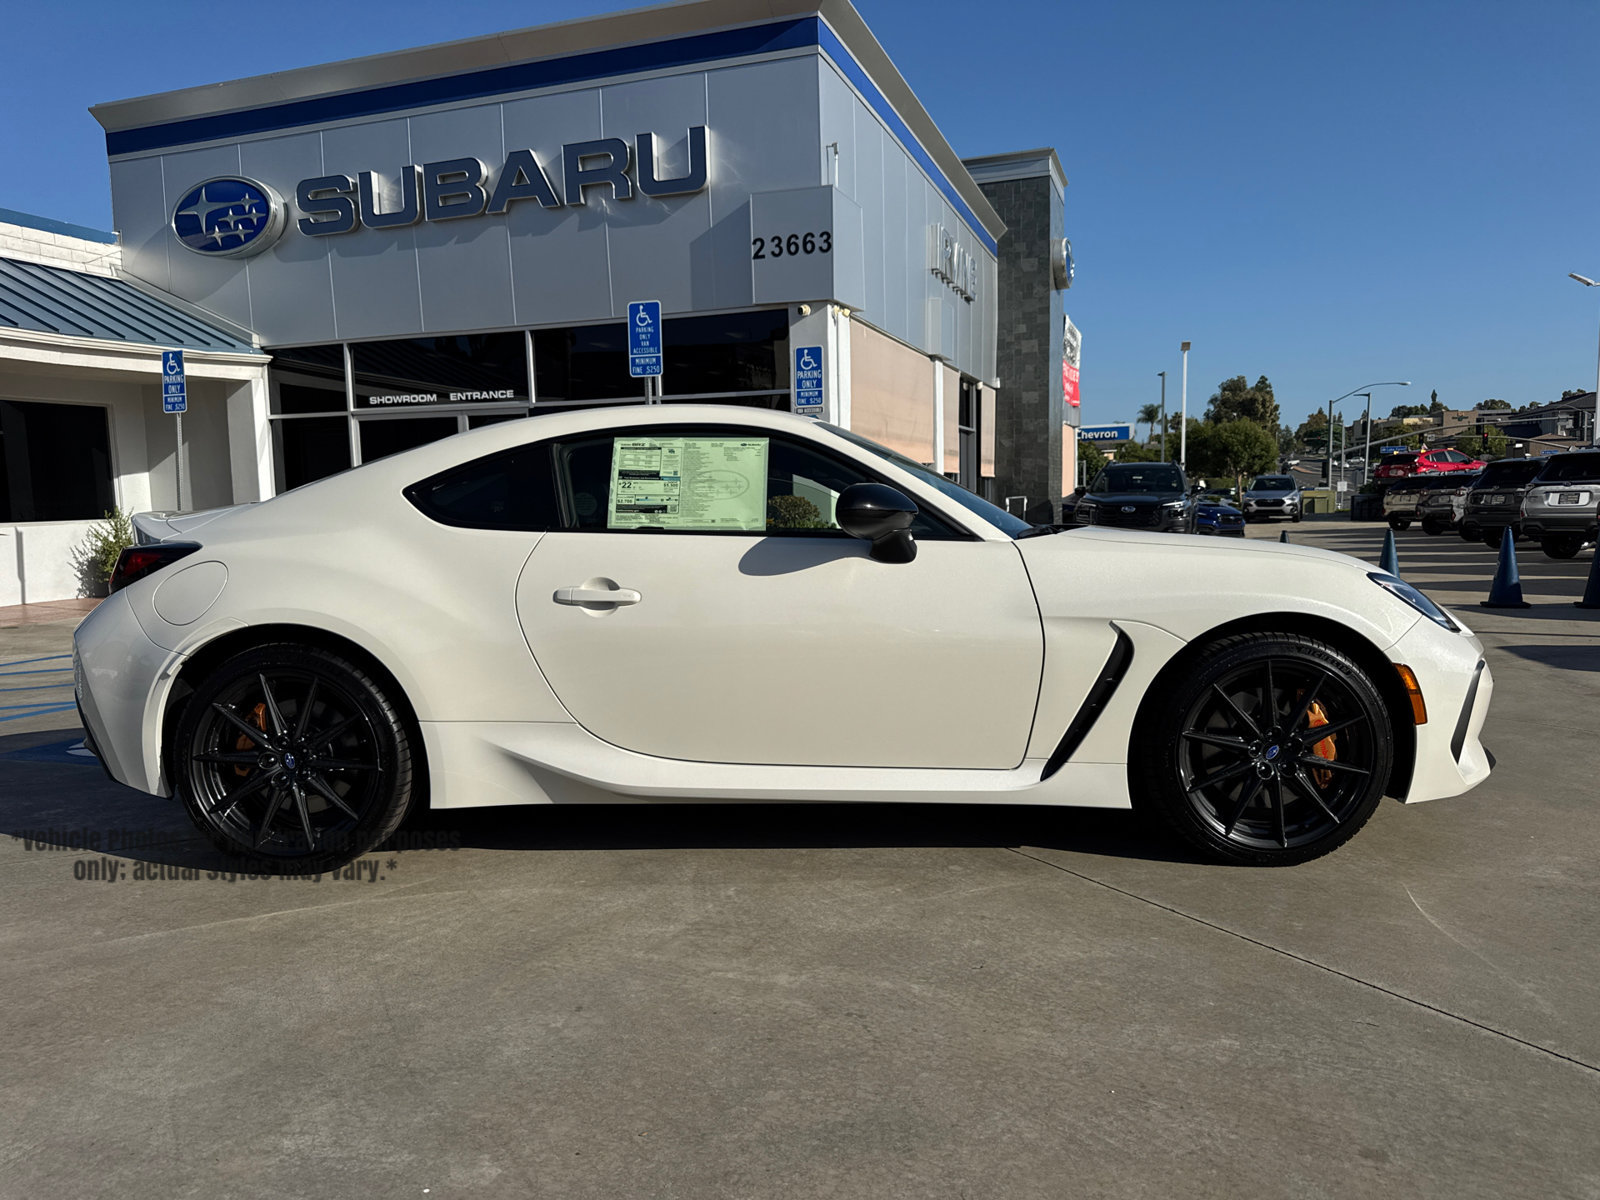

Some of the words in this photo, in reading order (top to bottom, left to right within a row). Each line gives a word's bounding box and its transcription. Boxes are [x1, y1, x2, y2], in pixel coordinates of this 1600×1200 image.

[296, 125, 710, 237] SUBARU
[752, 231, 832, 260] 23663
[632, 366, 643, 374] FINE
[646, 365, 660, 373] $250
[164, 374, 184, 384] PARKING
[797, 370, 821, 379] PARKING
[802, 380, 817, 389] ONLY
[168, 385, 180, 394] ONLY
[369, 394, 437, 404] SHOWROOM
[450, 390, 514, 400] ENTRANCE
[1077, 430, 1118, 439] Chevron
